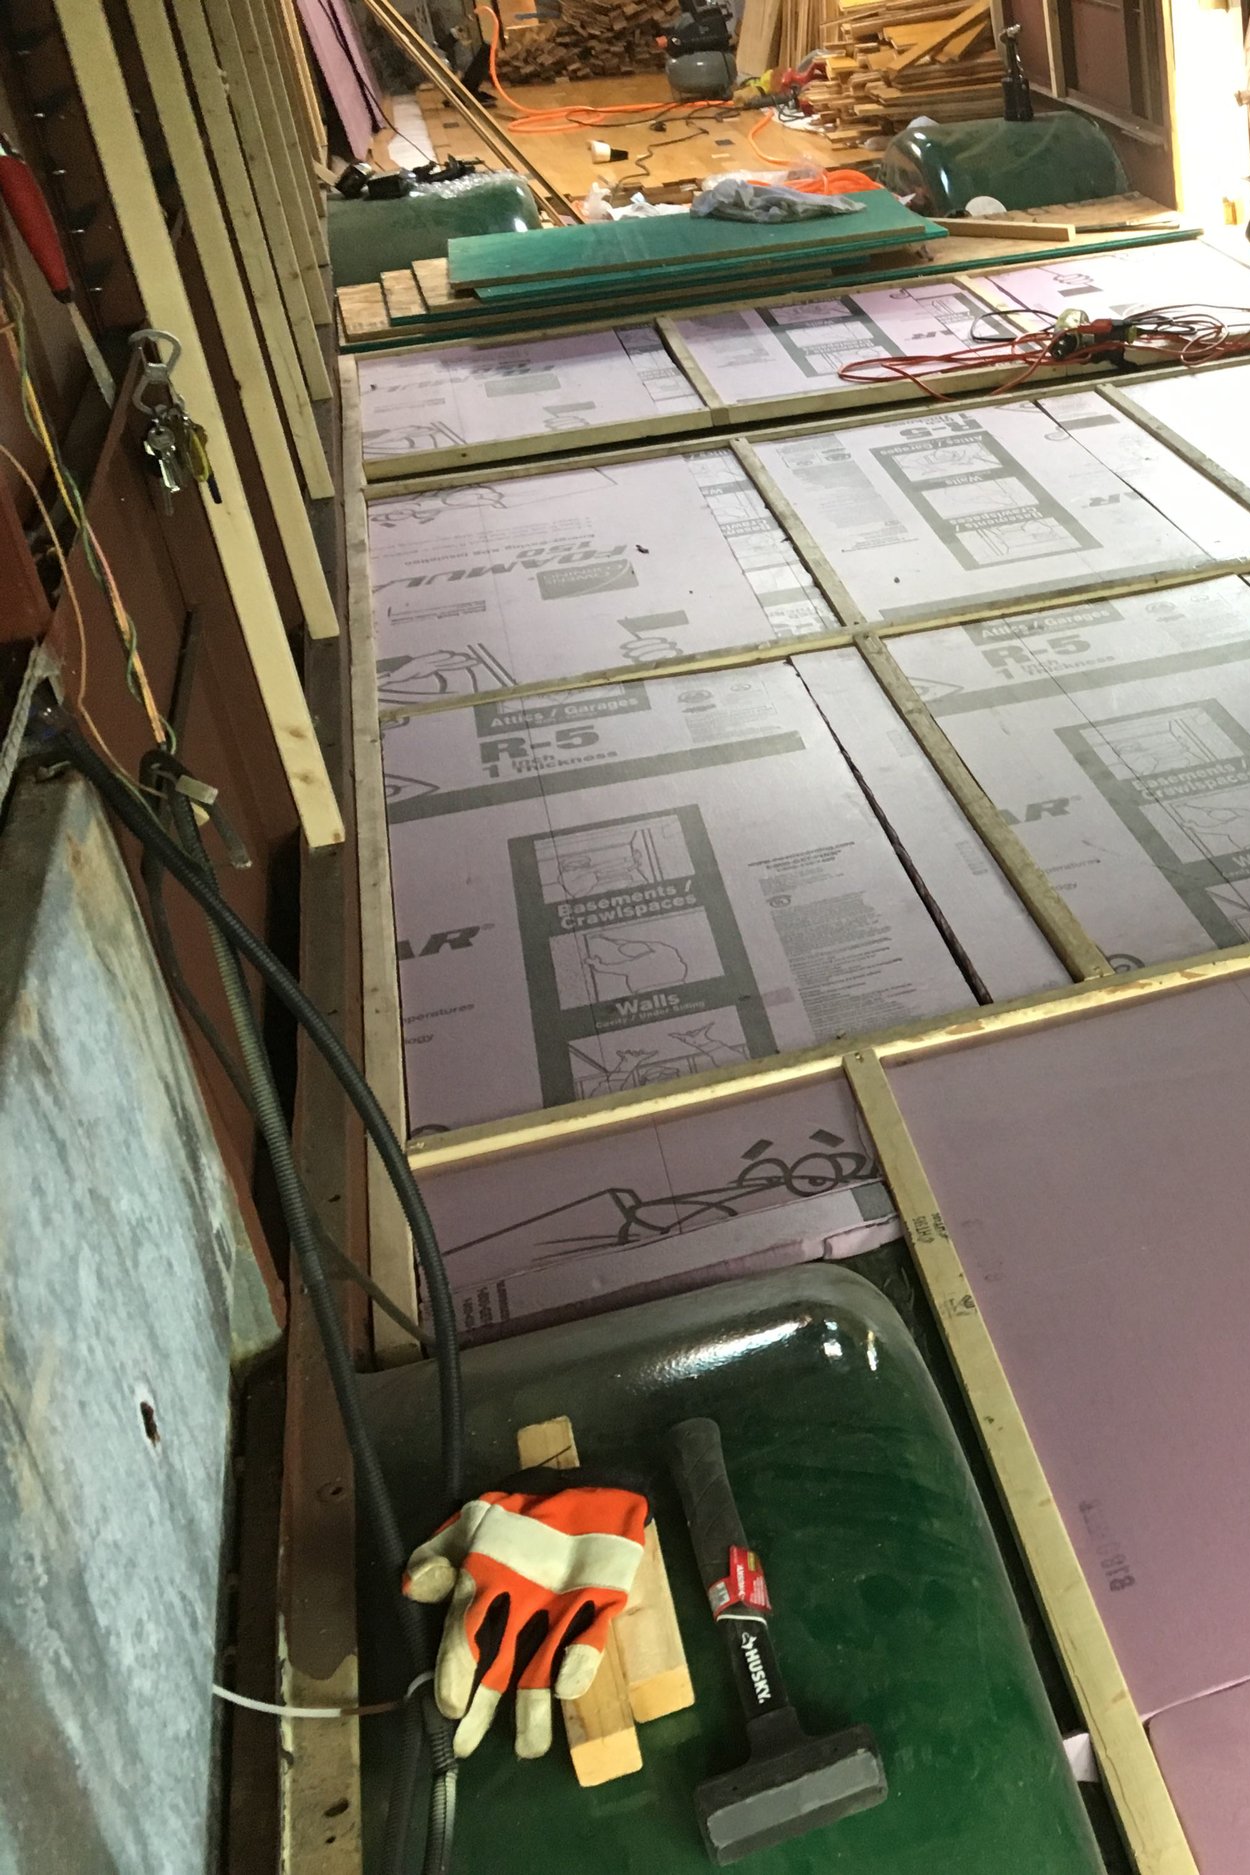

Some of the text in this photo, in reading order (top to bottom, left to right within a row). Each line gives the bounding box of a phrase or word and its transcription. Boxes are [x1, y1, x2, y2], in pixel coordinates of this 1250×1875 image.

[900, 418, 982, 440] R-5
[945, 475, 983, 485] Walls
[950, 506, 1037, 526] Crawlspaces
[968, 511, 1043, 529] Basements
[516, 541, 591, 559] 150
[982, 624, 1028, 638] Attics
[1044, 609, 1110, 626] Garages
[981, 634, 1091, 668] R-5
[996, 668, 1015, 679] 1
[490, 711, 544, 728] Attics
[564, 697, 640, 716] Garages
[479, 724, 600, 763] R-5
[483, 764, 500, 778] 1
[512, 750, 619, 773] Thickness
[1132, 762, 1236, 791] Basements
[557, 879, 692, 918] Basements /
[561, 894, 697, 929] Crawlspaces
[616, 993, 681, 1017] Walls
[745, 1648, 772, 1700] HUSKY
